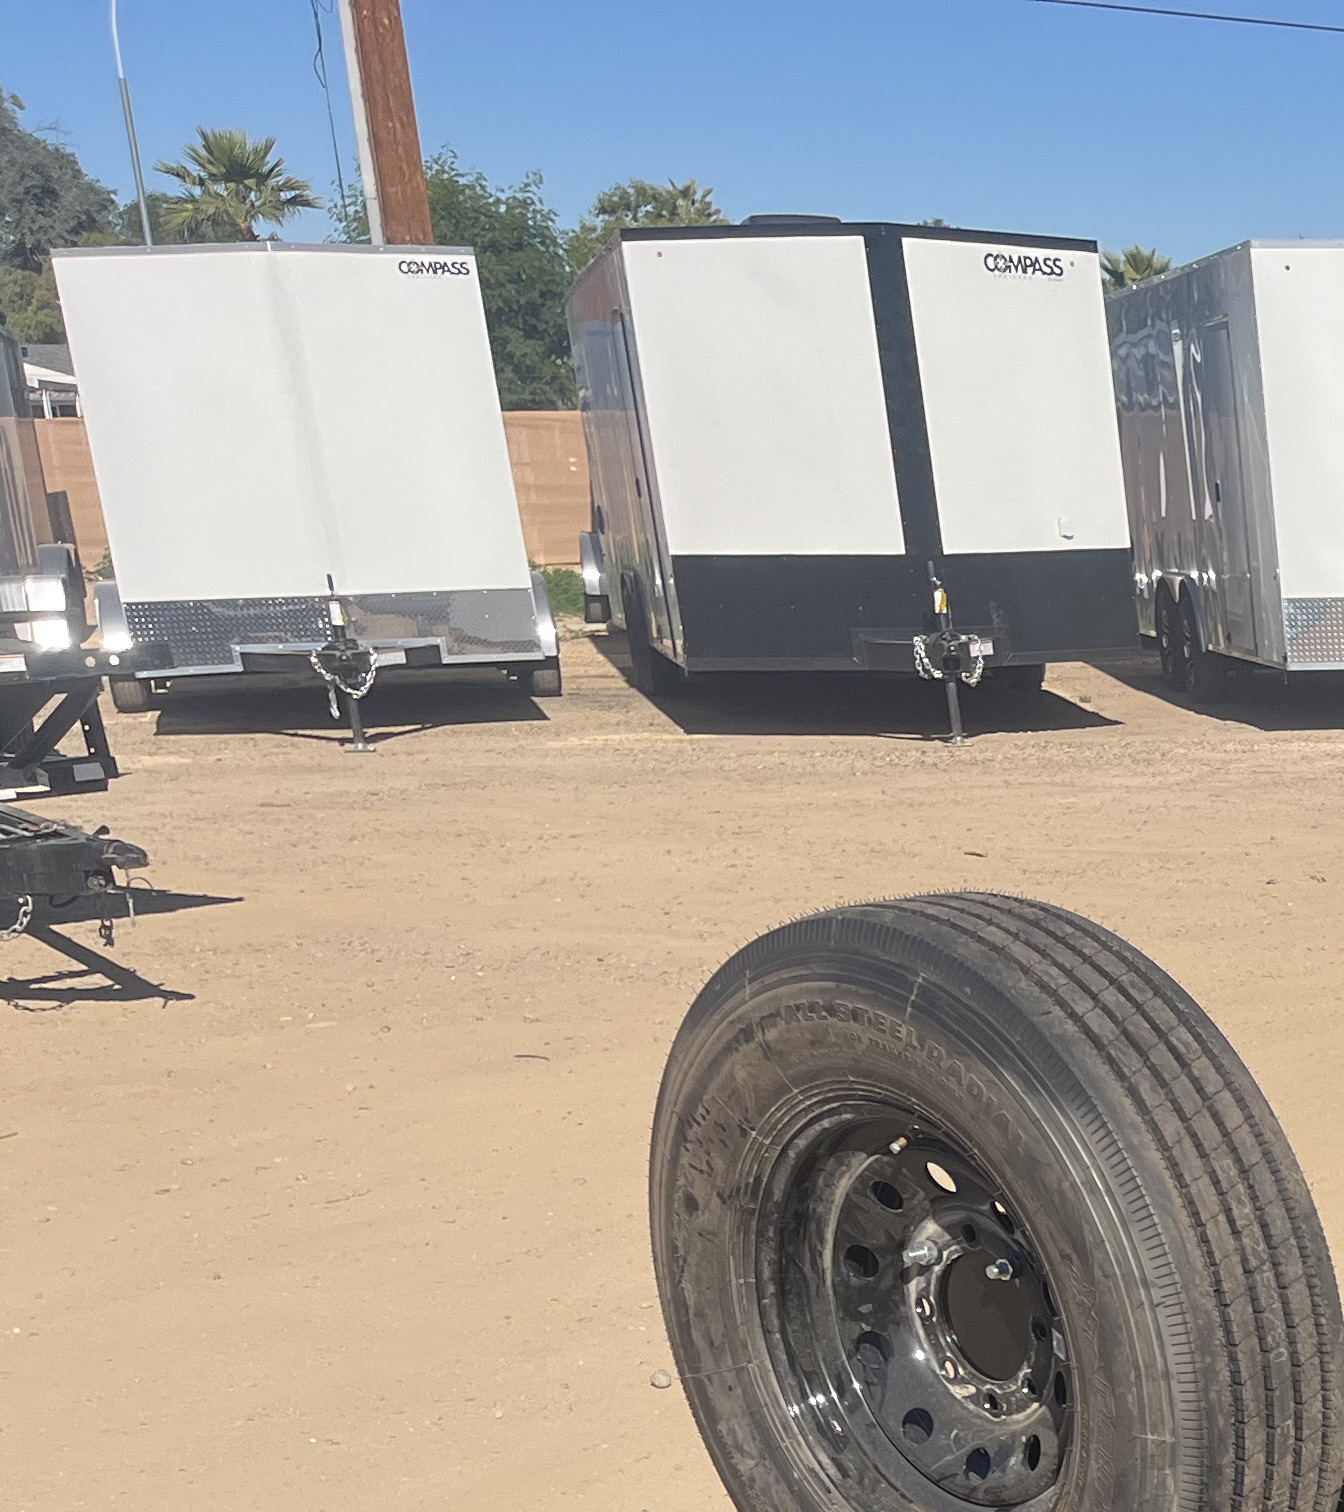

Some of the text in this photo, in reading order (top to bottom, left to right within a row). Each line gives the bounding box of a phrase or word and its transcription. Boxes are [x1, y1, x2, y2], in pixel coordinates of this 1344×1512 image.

[398, 260, 470, 275] COMPASS
[984, 253, 1064, 276] COMPASS
[780, 1000, 830, 1025] ALL
[832, 1000, 919, 1050] STEEL
